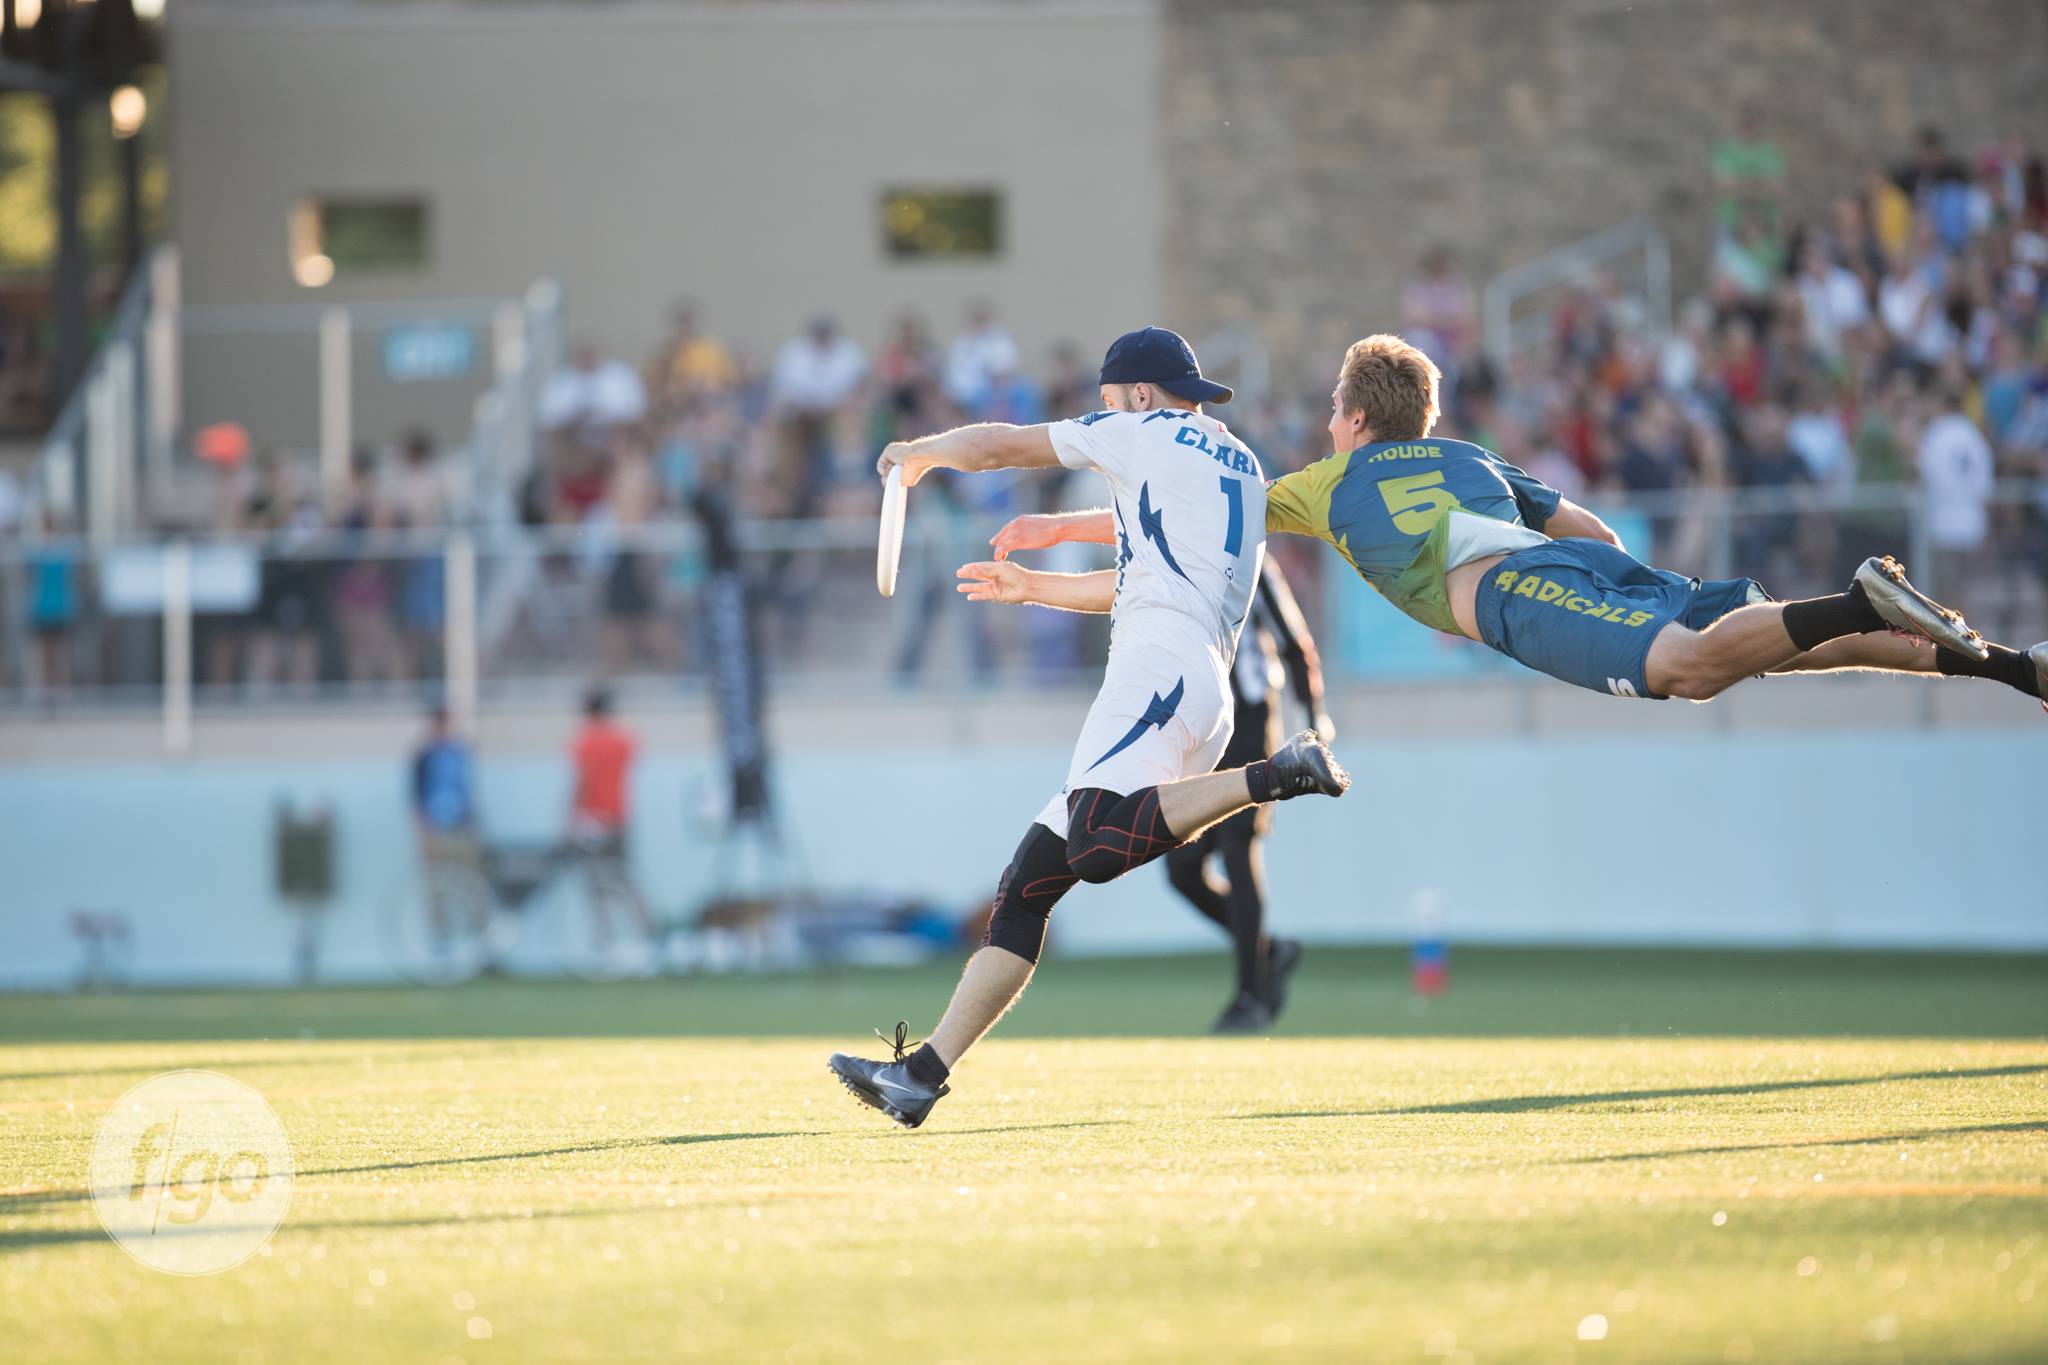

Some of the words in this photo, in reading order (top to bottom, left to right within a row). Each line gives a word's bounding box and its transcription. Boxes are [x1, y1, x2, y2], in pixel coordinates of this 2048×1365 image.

[1219, 475, 1244, 559] 1
[1377, 470, 1459, 536] 5
[1494, 570, 1655, 627] RADICALS
